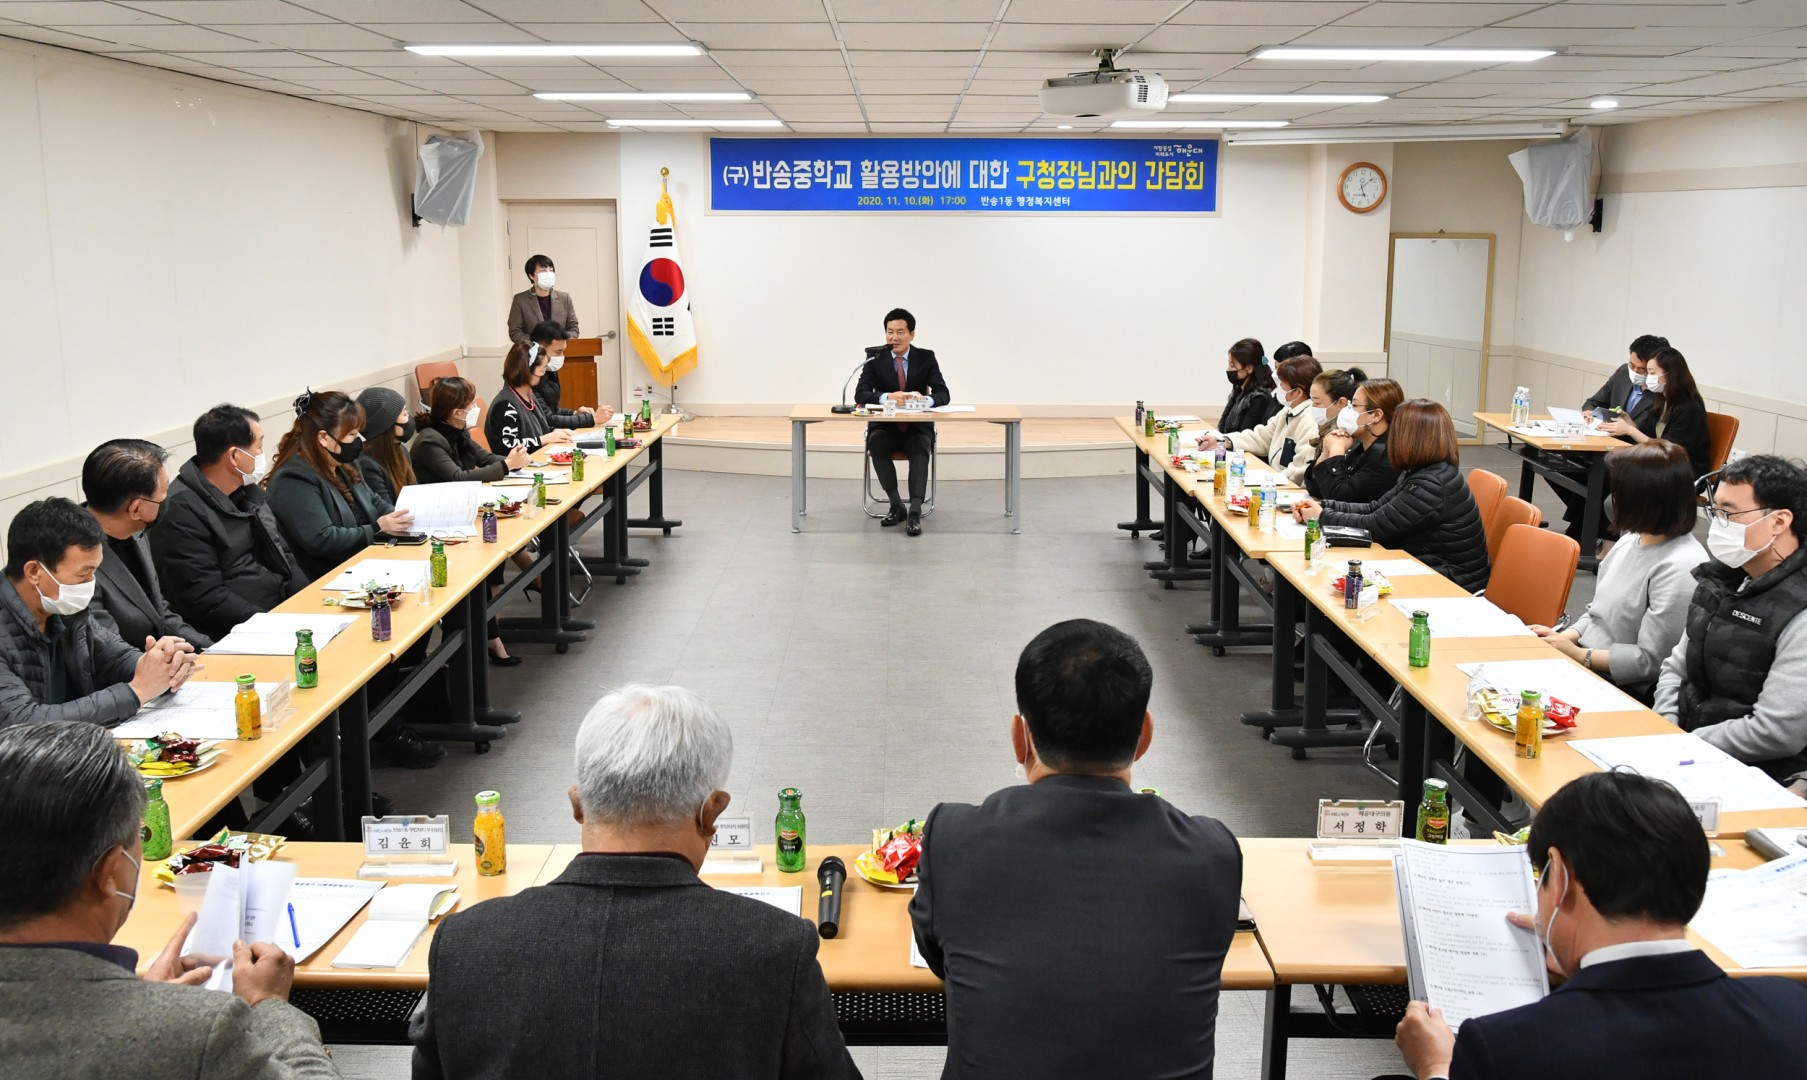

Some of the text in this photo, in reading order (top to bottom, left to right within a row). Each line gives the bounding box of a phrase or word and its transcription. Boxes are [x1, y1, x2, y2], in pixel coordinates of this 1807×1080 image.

[860, 159, 961, 190] 활용방안에
[969, 159, 1009, 190] 대한
[1016, 159, 1136, 190] 구청장님과의
[1145, 159, 1205, 190] 간담회
[857, 196, 883, 206] 2020.
[887, 197, 900, 206] 11.
[940, 196, 967, 206] 17:00
[980, 196, 1013, 207] 반송1동
[1016, 196, 1071, 207] 행정복지센터
[1731, 609, 1762, 626] DESCENTE
